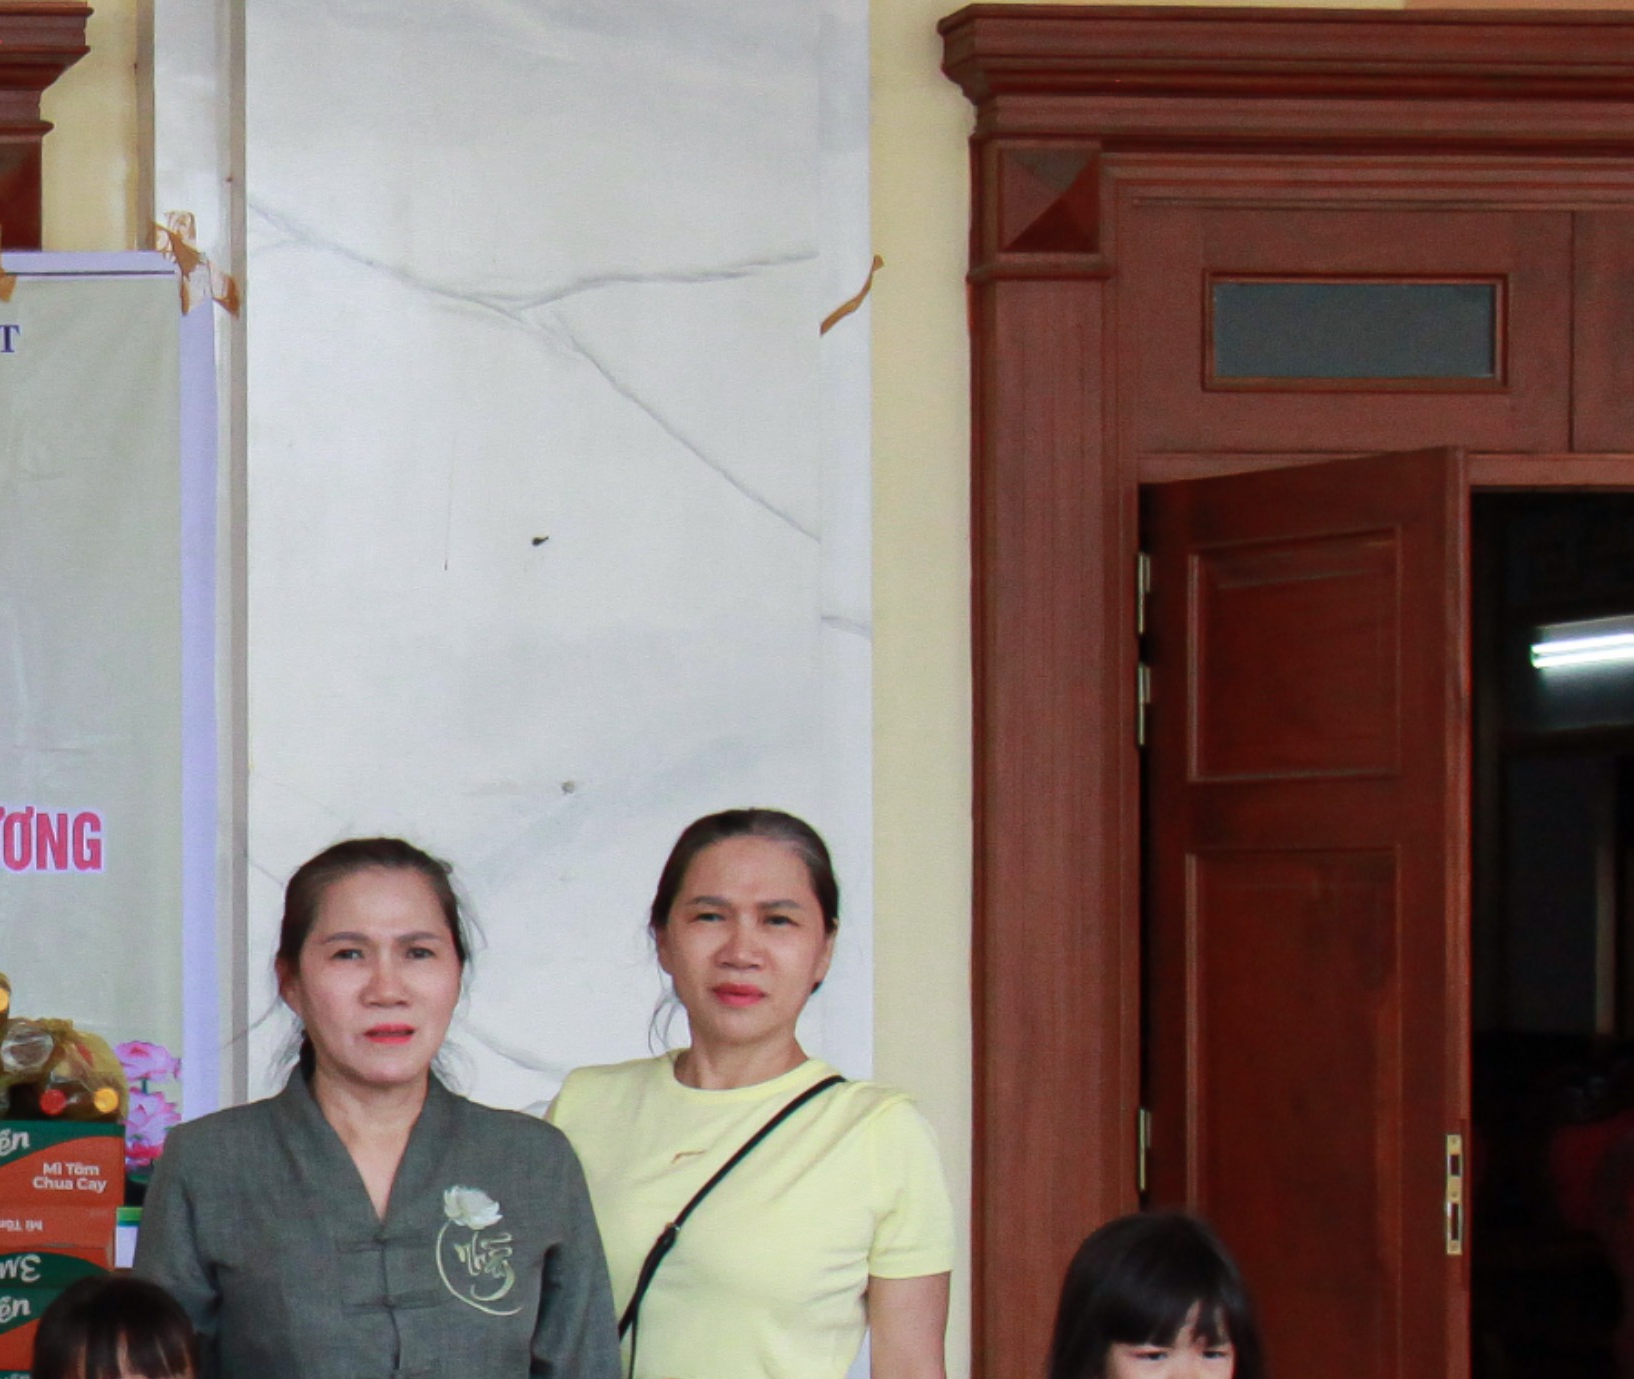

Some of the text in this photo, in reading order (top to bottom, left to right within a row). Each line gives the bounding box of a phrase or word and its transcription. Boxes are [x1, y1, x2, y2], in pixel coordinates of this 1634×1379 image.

[66, 1161, 100, 1176] Tôm
[33, 1176, 107, 1193] Chua Cay
